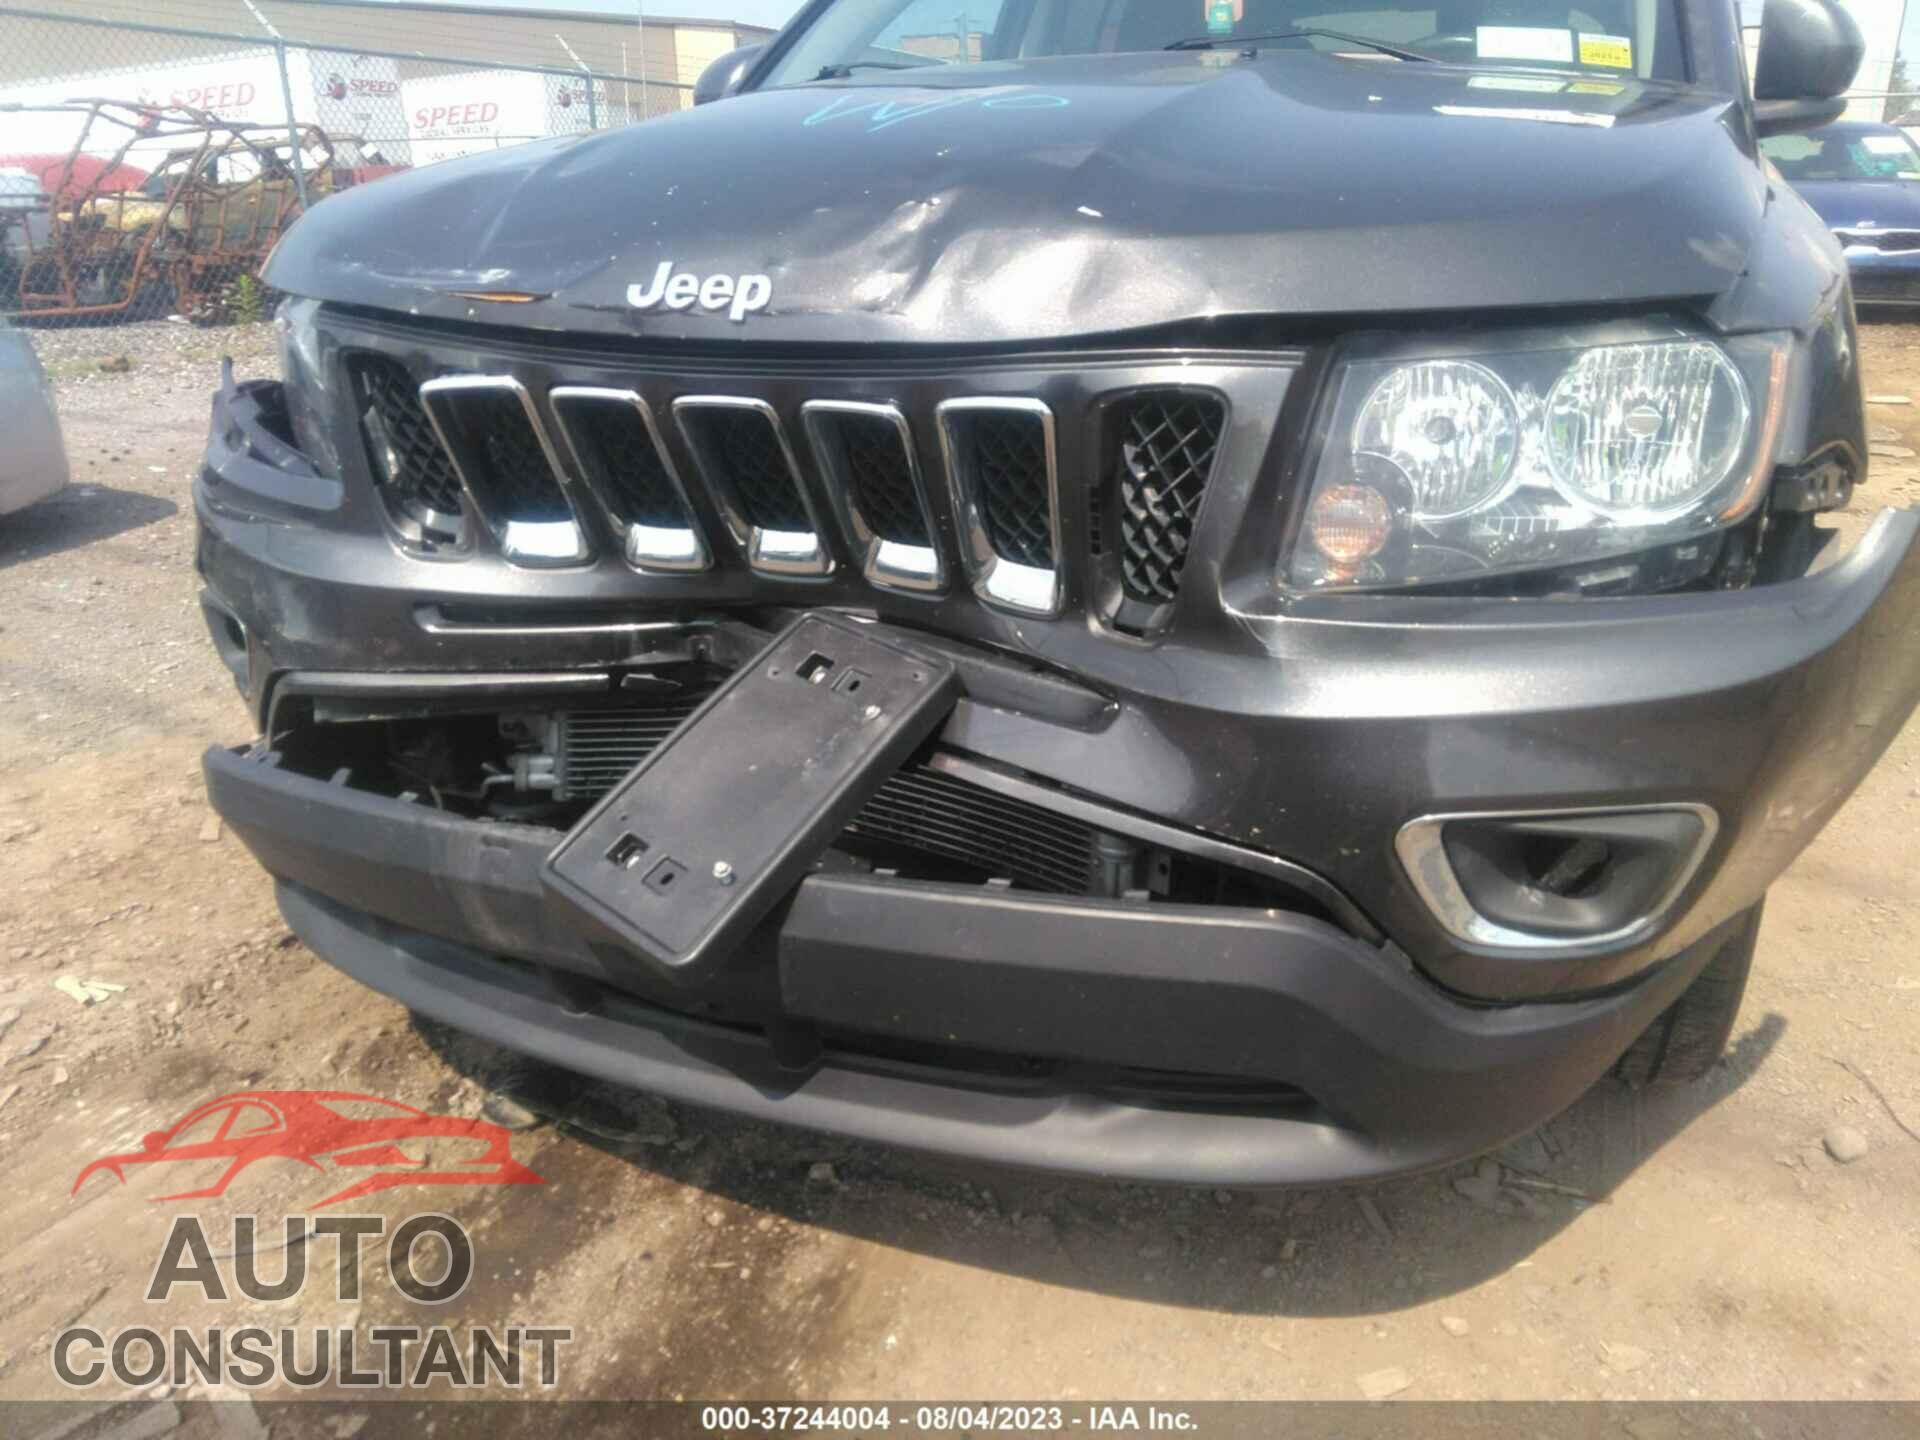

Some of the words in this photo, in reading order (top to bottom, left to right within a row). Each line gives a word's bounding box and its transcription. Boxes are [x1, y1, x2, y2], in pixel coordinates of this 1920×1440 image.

[169, 82, 257, 112] SPEED
[350, 79, 399, 93] SPEED
[414, 102, 499, 129] SPEED
[627, 261, 772, 320] Jeep
